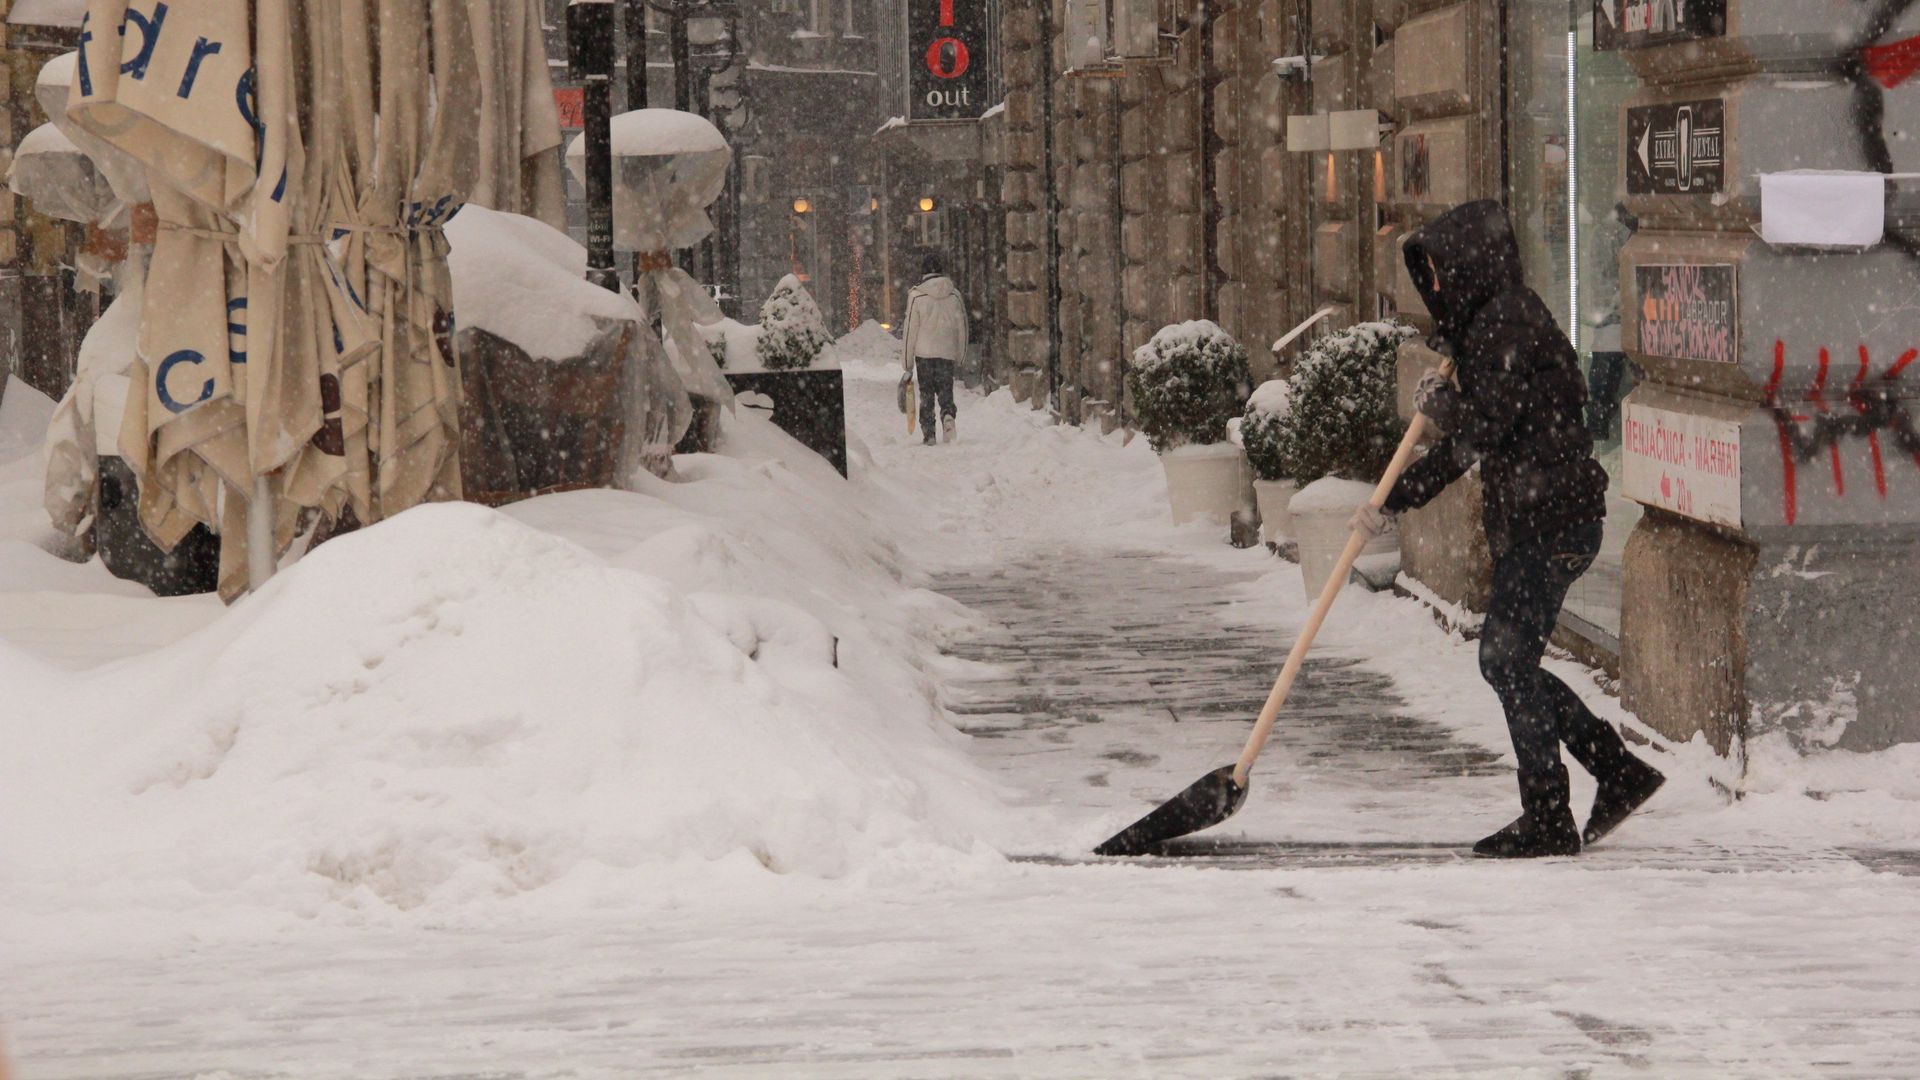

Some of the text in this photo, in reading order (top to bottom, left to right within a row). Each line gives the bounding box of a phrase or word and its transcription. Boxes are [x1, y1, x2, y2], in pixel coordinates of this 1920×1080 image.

[926, 86, 970, 107] out
[1655, 136, 1720, 159] EXTRA DENTAL
[1681, 299, 1728, 325] LABRADOR
[1625, 418, 1686, 467] MENJAČNICA
